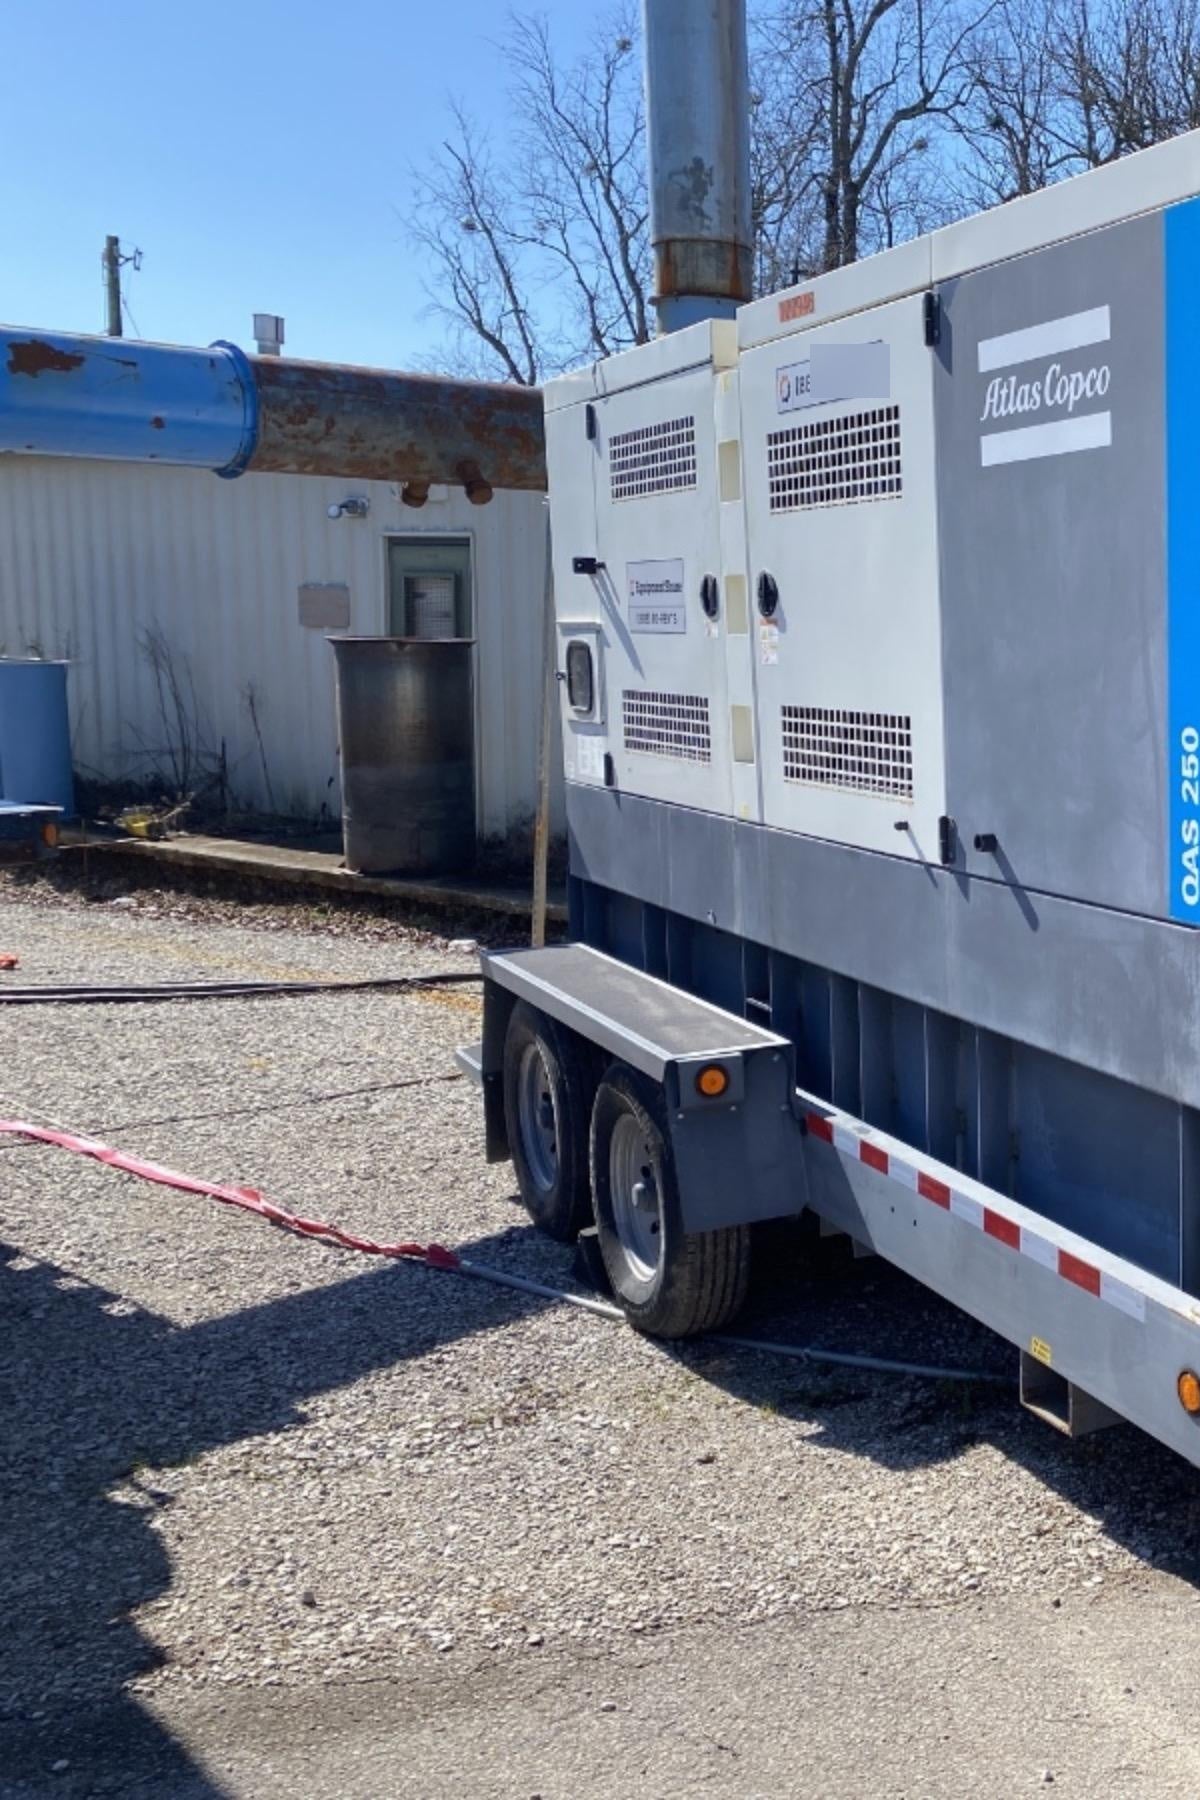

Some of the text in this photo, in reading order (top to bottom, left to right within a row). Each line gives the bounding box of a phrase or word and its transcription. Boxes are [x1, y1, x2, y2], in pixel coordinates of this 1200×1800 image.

[980, 363, 1111, 421] Atlas Copco
[1181, 725, 1200, 906] QAS 250
